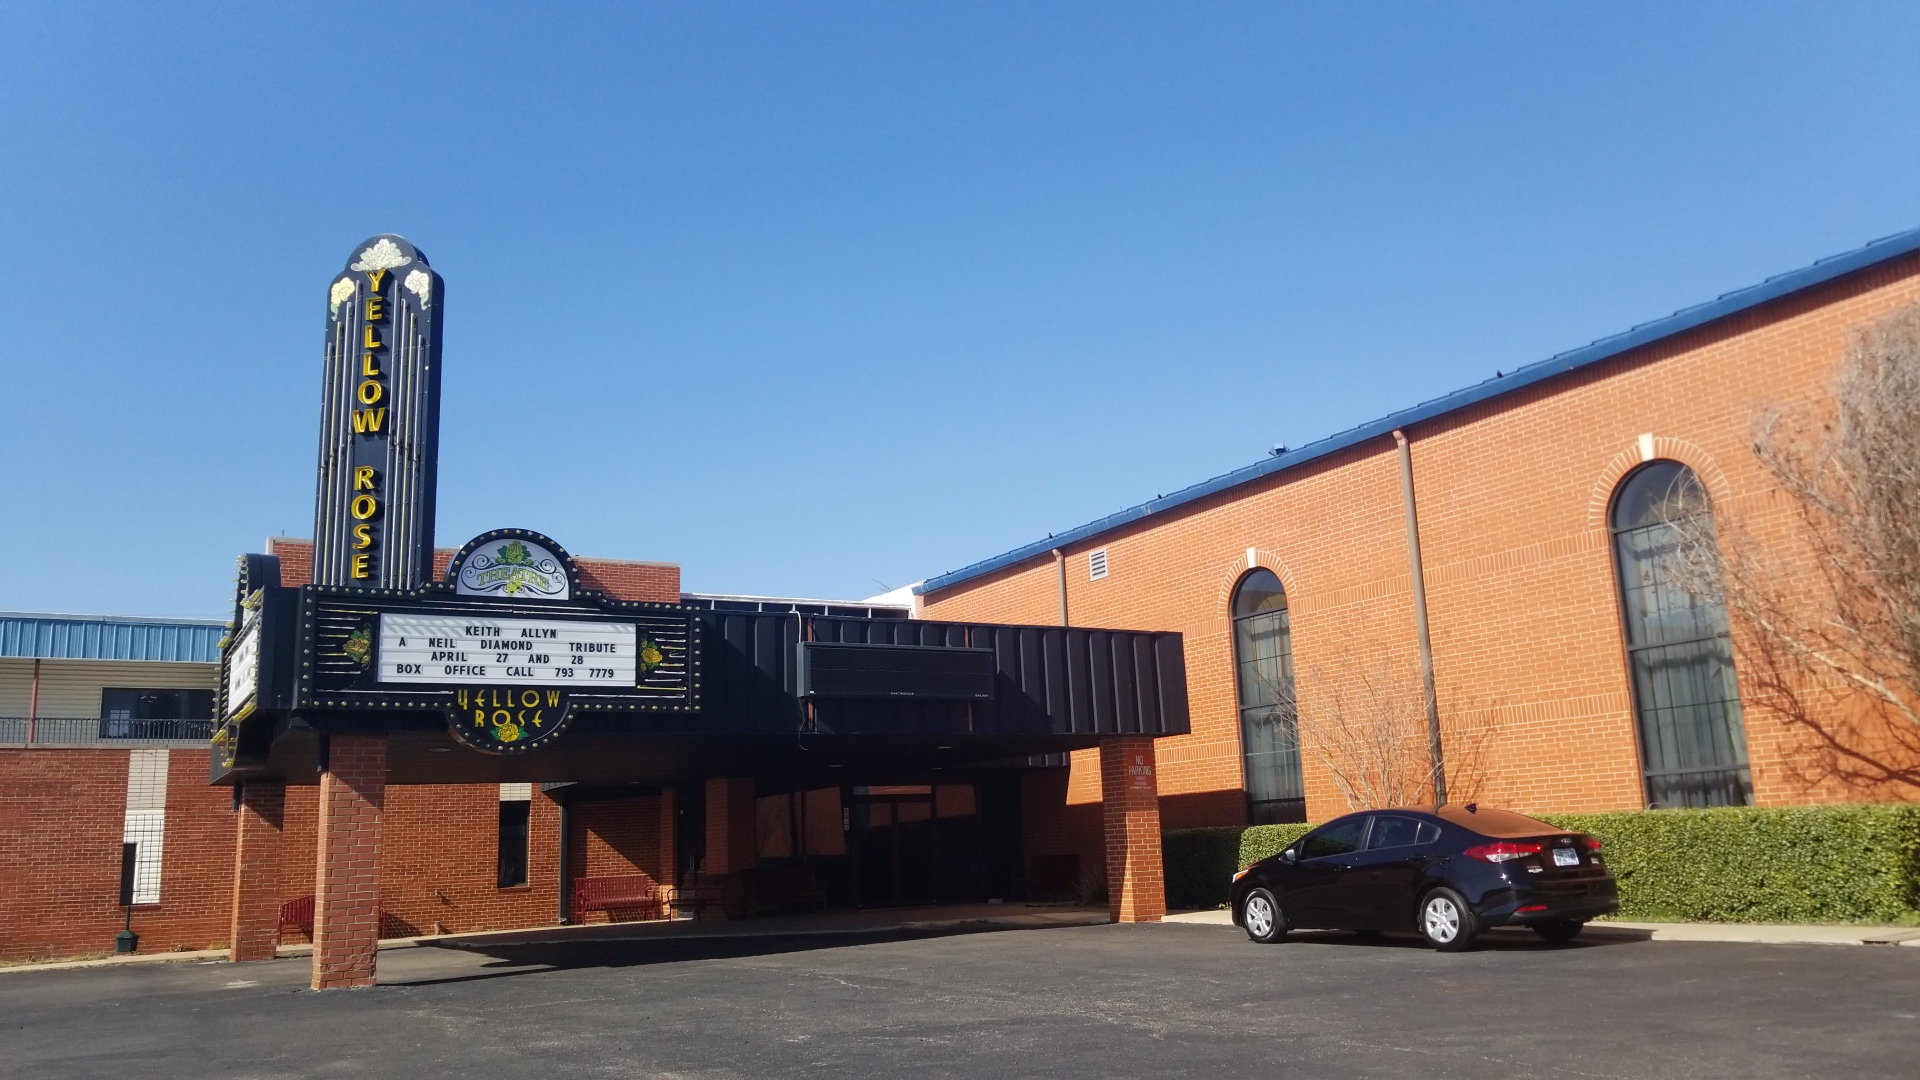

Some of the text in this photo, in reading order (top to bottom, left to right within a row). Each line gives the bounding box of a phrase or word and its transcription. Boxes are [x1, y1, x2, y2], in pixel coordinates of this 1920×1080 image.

[351, 269, 386, 580] YELLOW ROSE
[476, 567, 550, 591] THEATRE
[465, 626, 557, 639] KEITH ALLYN
[399, 637, 616, 653] A NEIL DIAMOND TRIBUTE
[431, 651, 584, 665] APRIL 27 AND 28
[396, 664, 615, 679] BOX OFFICE CALL 793 7779
[457, 689, 560, 709] YELLOW
[474, 710, 543, 727] ROSE
[1135, 755, 1144, 765] NO
[1128, 765, 1152, 775] PARKING
